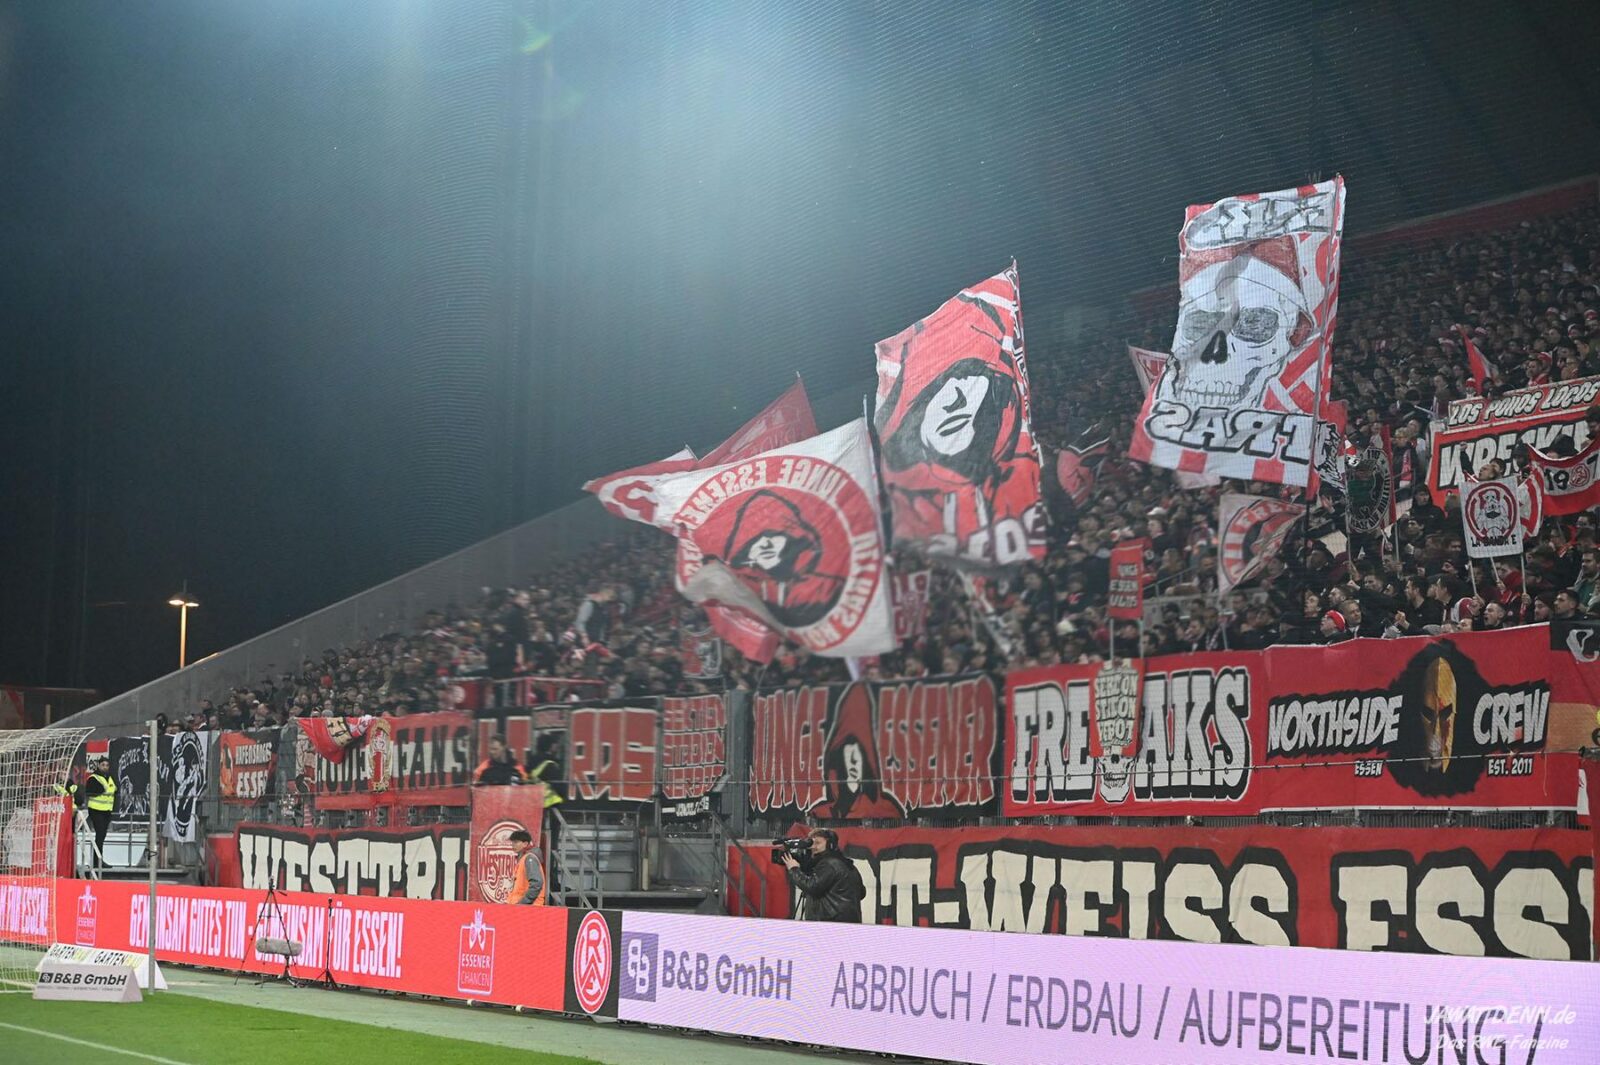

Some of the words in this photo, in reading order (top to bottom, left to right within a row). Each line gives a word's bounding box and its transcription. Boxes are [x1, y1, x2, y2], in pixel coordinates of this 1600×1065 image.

[1448, 401, 1483, 426] LOS
[1268, 694, 1403, 755] NORTHSIDE
[1473, 689, 1550, 746] CREW
[877, 676, 997, 810] ESSENER
[1354, 760, 1383, 777] ESSEN
[1488, 759, 1509, 776] EST.
[1511, 758, 1533, 775] 2011
[239, 833, 469, 901] WESTTRI
[189, 898, 222, 957] GUTES
[224, 900, 246, 960] TUN
[353, 909, 404, 979] ESSEN!
[53, 972, 82, 985] B&B
[84, 974, 127, 986] GmbH
[460, 970, 490, 987] CHANCEN
[461, 953, 491, 969] ESSENER
[662, 950, 709, 992] B&B
[715, 953, 793, 1001] GmbH
[831, 961, 971, 1022] ABBRUCH
[1006, 974, 1143, 1040] ERDBAU
[1179, 987, 1507, 1065] AUFBEREITUNG
